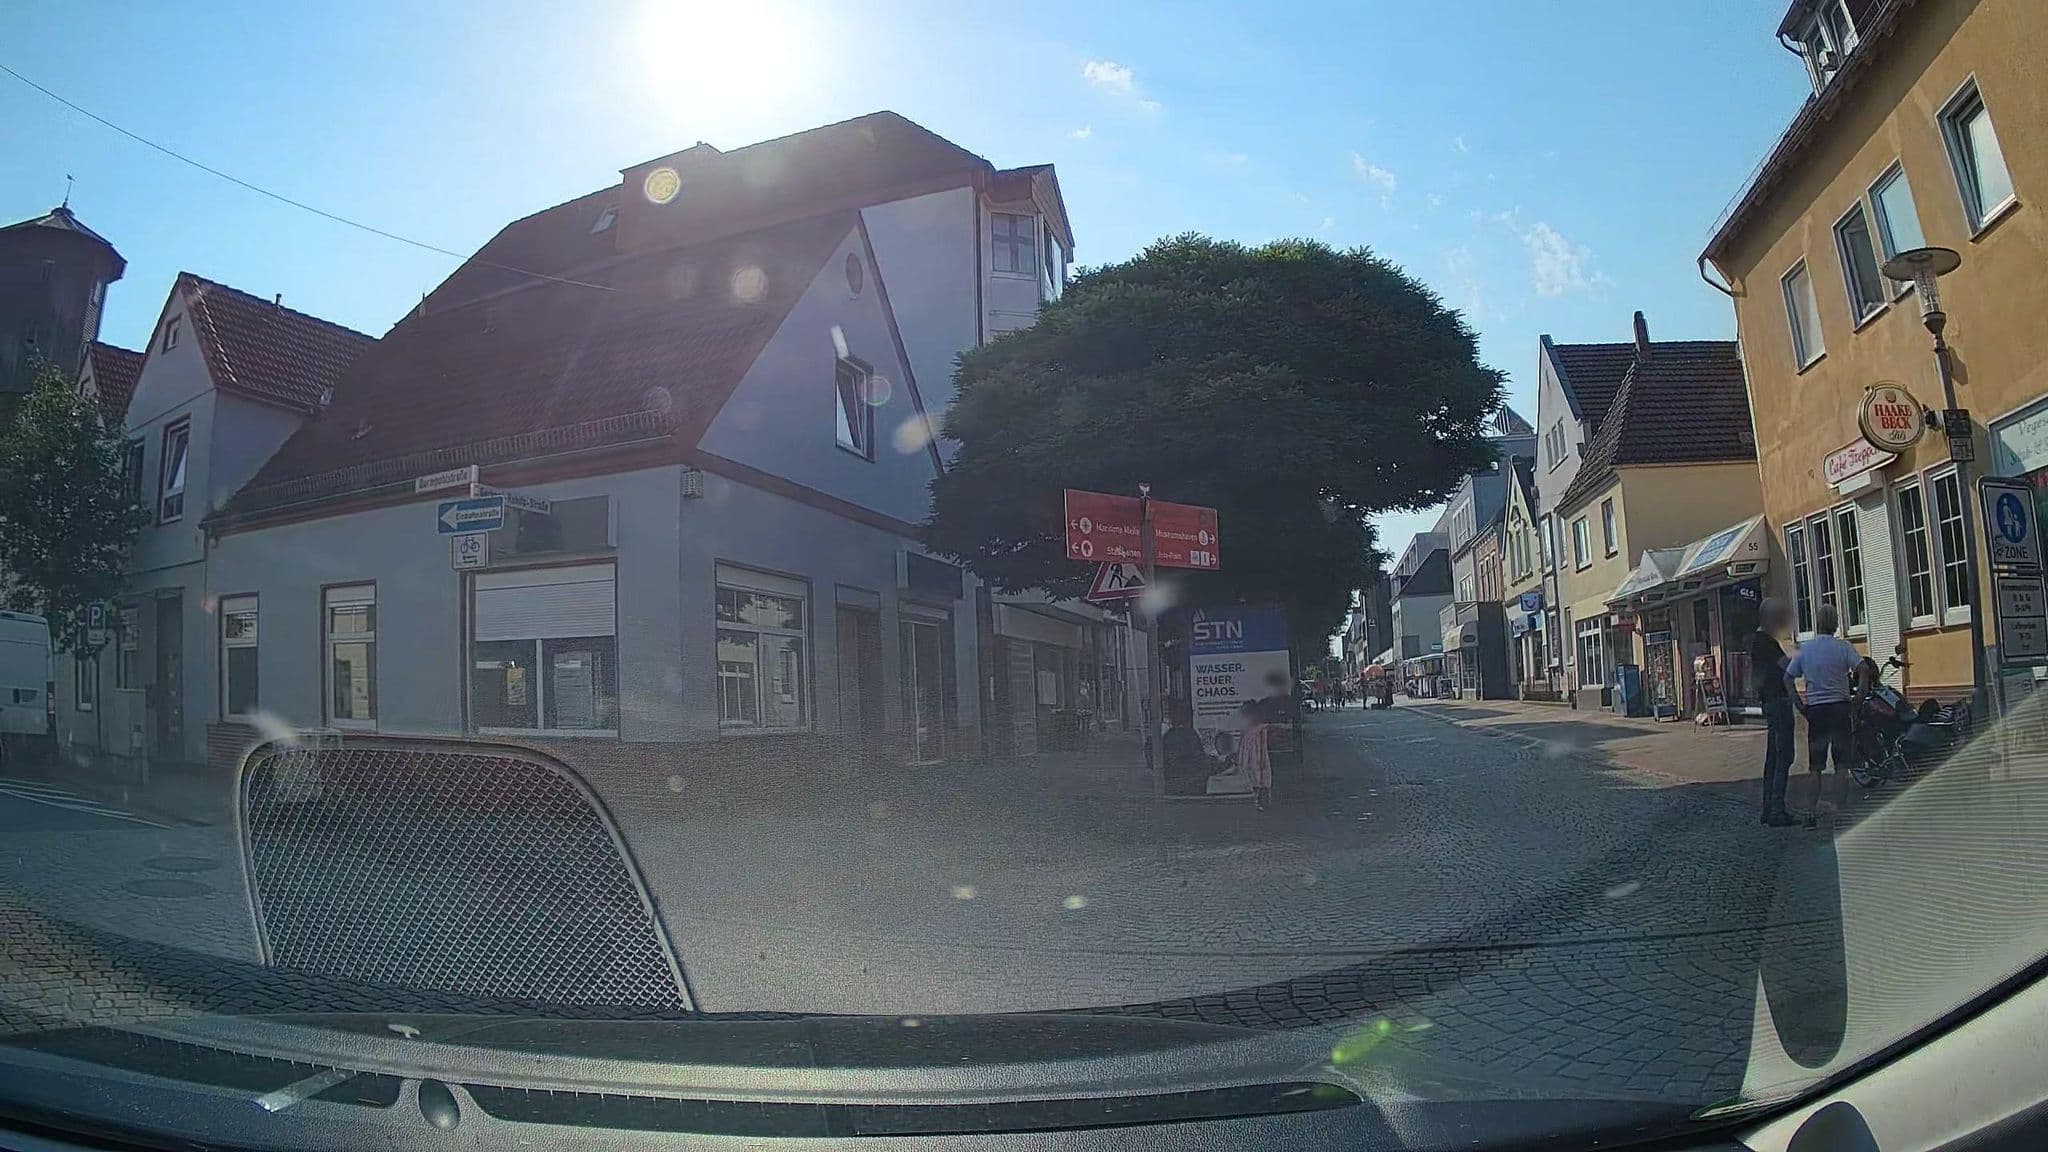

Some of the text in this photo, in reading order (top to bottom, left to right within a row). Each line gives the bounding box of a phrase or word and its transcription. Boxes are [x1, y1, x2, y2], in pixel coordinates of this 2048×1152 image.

[1874, 404, 1912, 417] HAAKE
[1881, 417, 1912, 429] BECK
[1829, 453, 1848, 477] Café
[456, 508, 499, 521] Einbahnstraße
[1748, 542, 1759, 551] 55
[2005, 545, 2029, 559] ZONE
[1740, 588, 1754, 597] GLS
[91, 606, 101, 627] P
[1193, 620, 1242, 641] STN
[1195, 662, 1246, 675] WASSER.
[1196, 675, 1235, 686] FEUER.
[1197, 686, 1239, 698] CHAOS.
[1706, 695, 1722, 705] GLS
